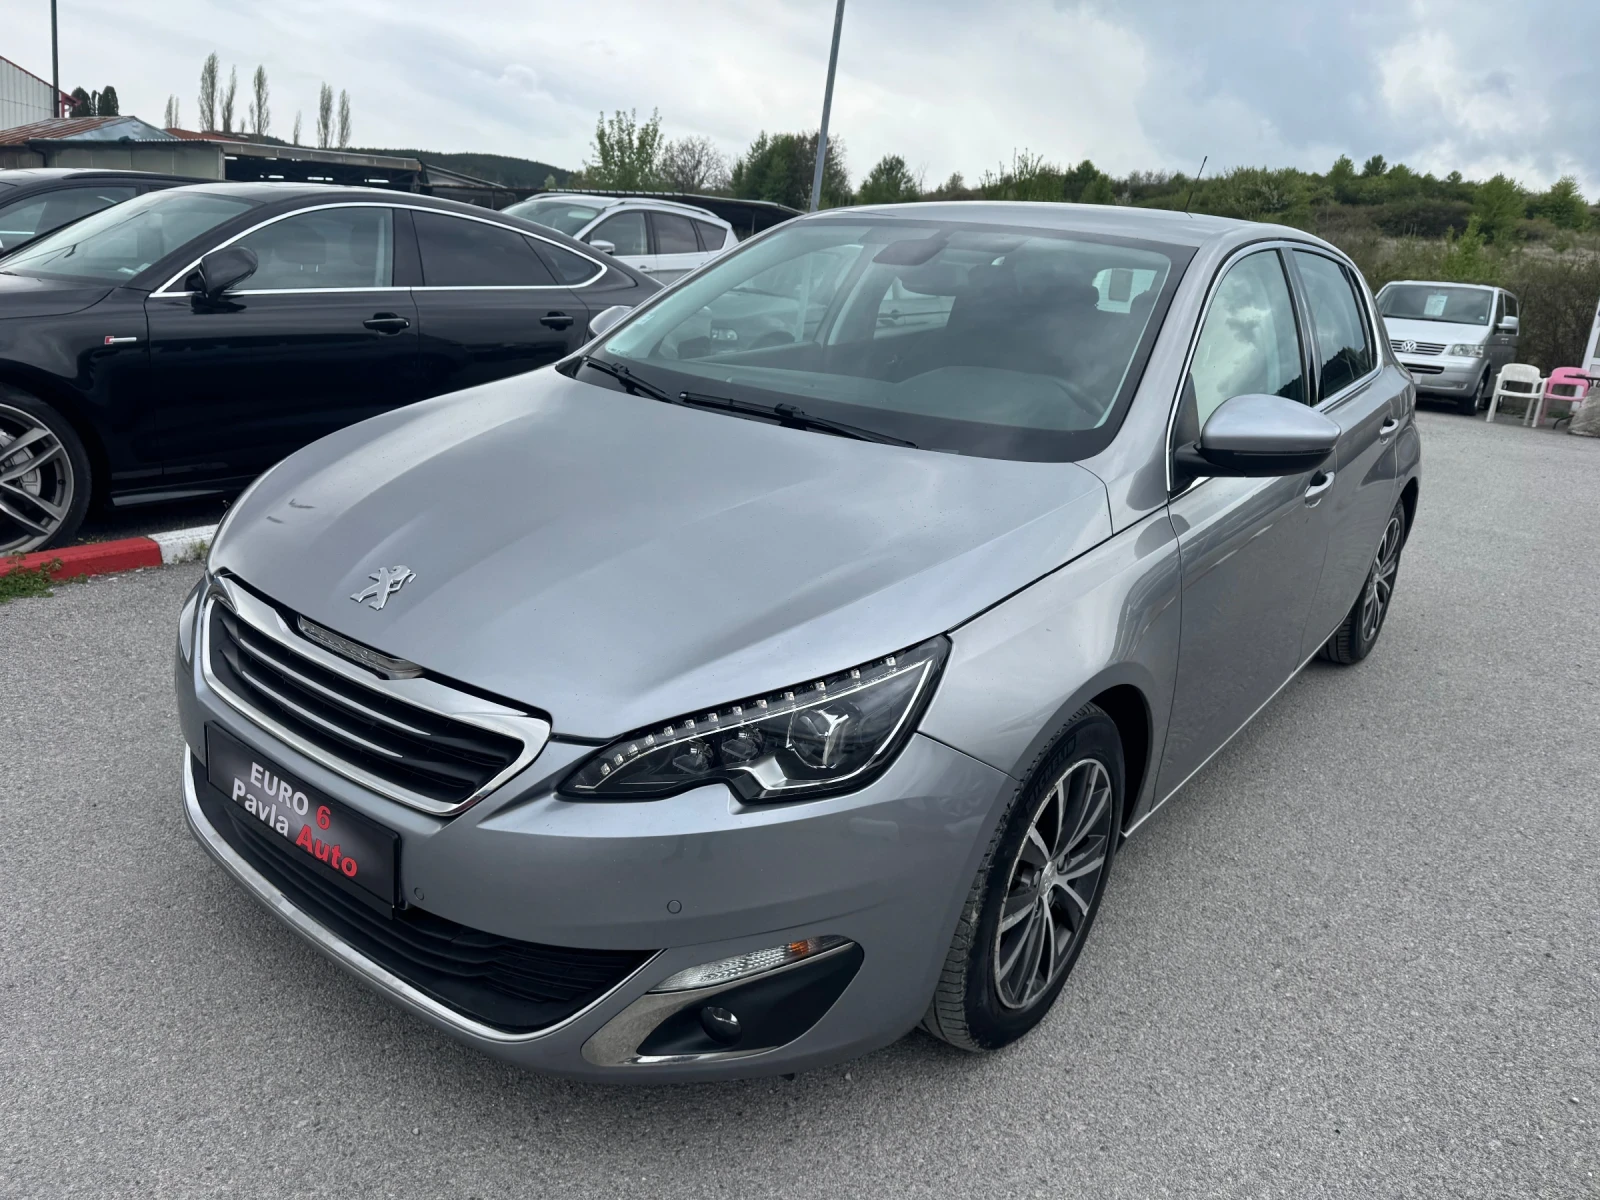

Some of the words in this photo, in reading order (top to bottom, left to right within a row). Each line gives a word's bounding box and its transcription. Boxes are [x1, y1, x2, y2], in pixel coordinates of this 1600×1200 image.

[232, 777, 289, 838] Pavla
[295, 824, 358, 878] Auto
[250, 761, 309, 816] EURO
[316, 805, 331, 831] 6
